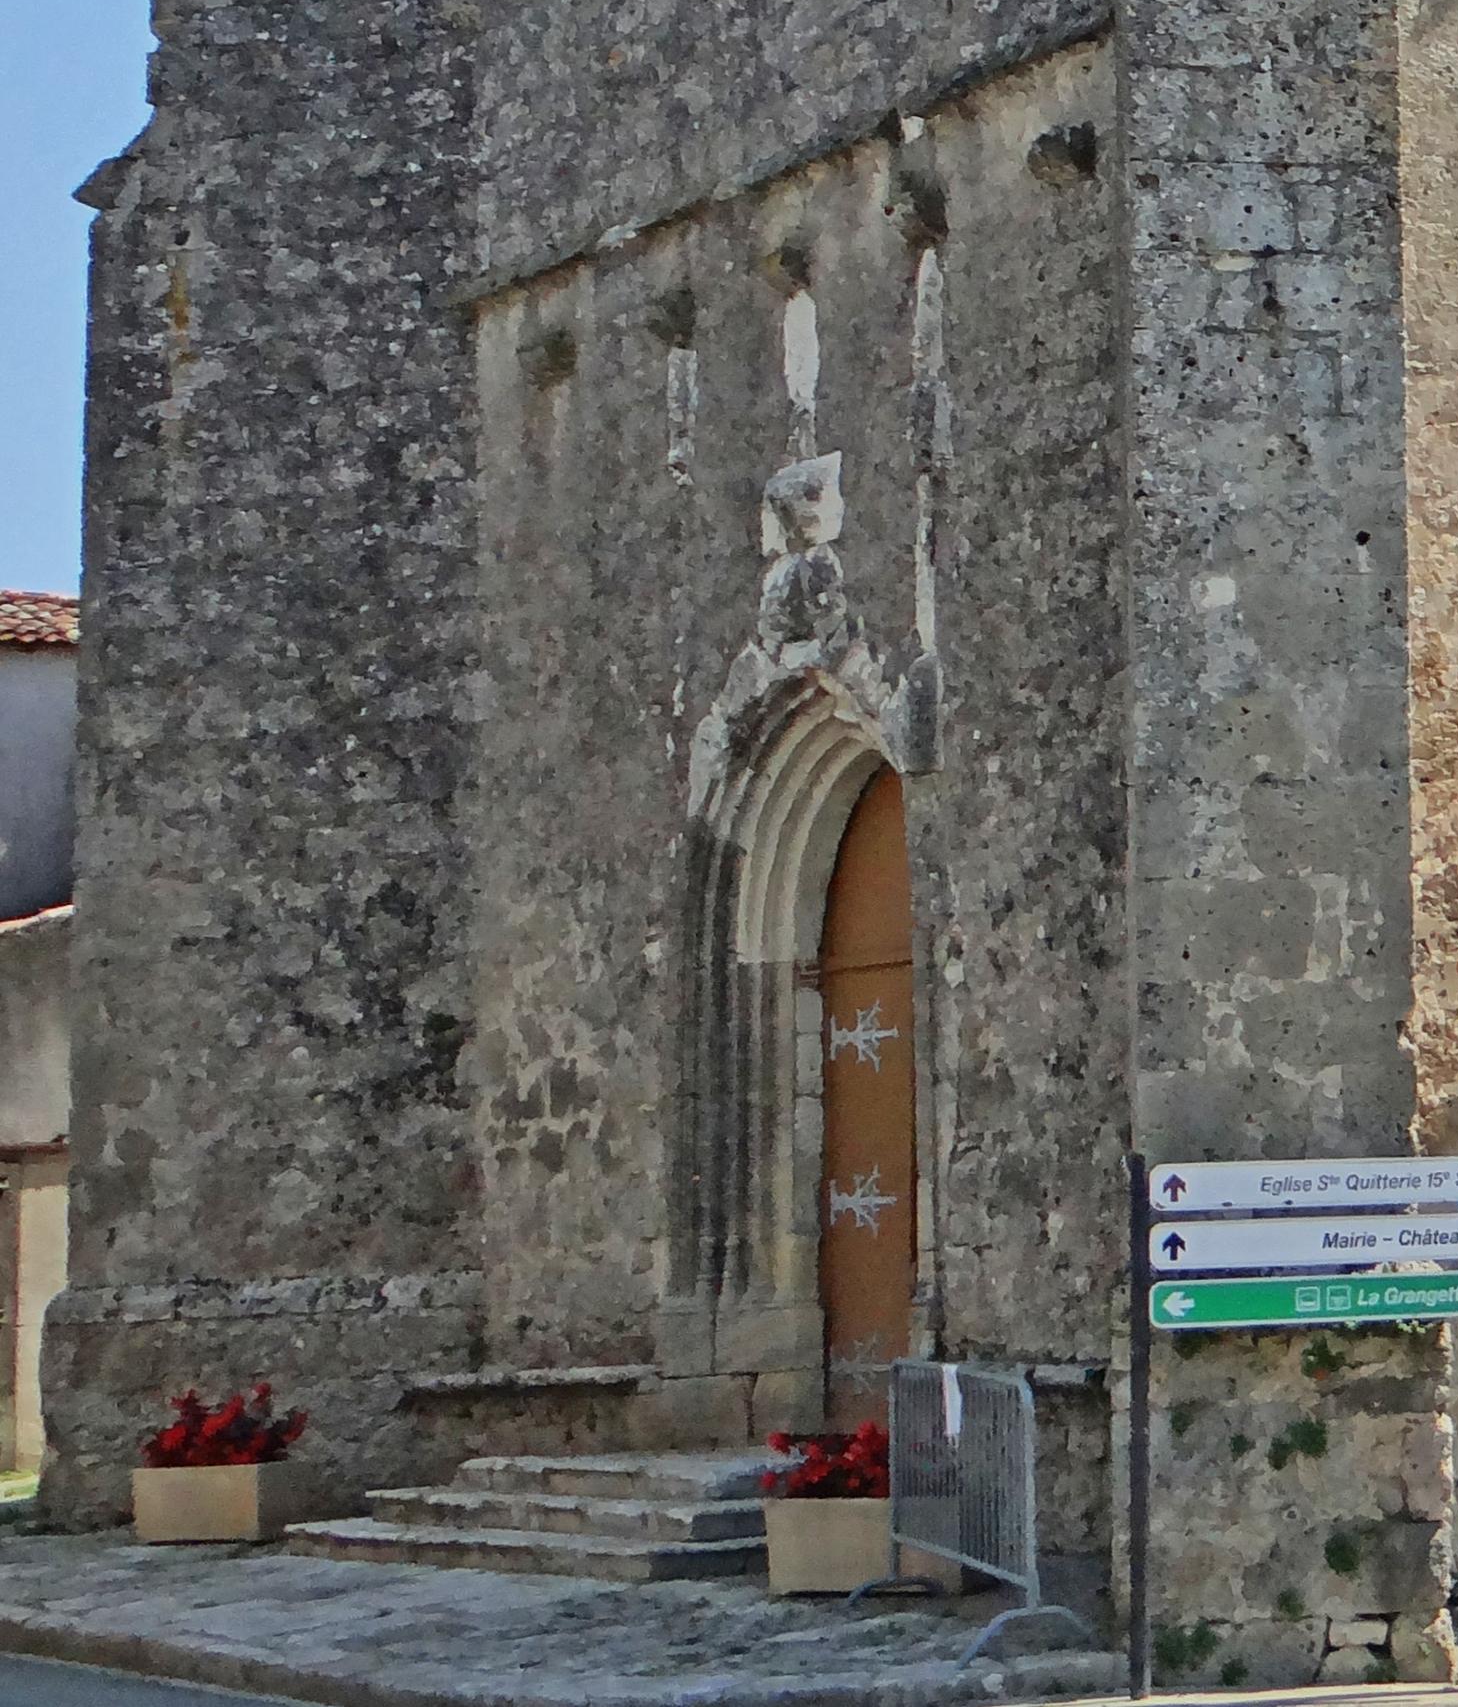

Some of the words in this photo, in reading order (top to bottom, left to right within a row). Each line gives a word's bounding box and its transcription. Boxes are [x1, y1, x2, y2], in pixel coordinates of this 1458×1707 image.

[1260, 1175, 1312, 1196] Eglise
[1346, 1172, 1422, 1191] Quitterie
[1322, 1231, 1377, 1249] Mairie
[1357, 1288, 1380, 1306] La
